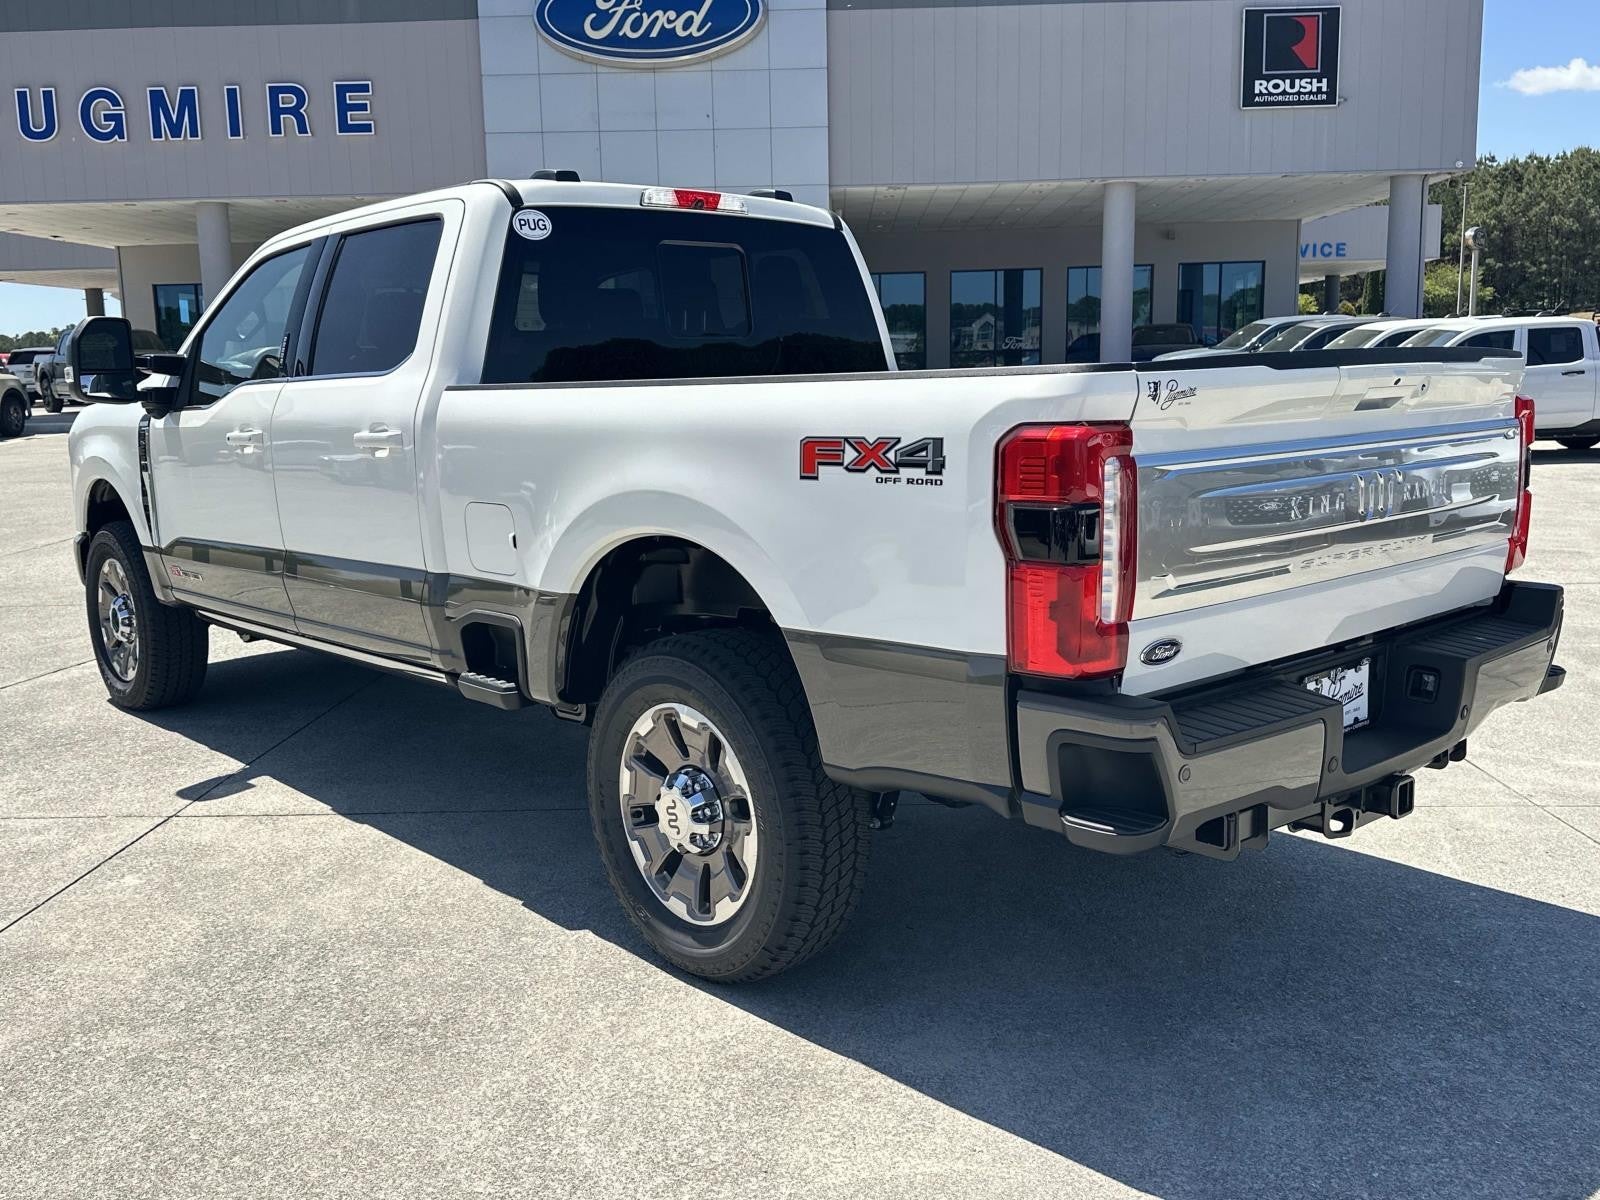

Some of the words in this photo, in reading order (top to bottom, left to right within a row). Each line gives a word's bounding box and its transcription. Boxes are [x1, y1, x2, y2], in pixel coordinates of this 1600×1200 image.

[583, 0, 712, 39] Ford
[1254, 78, 1328, 94] ROUSH
[1254, 94, 1299, 103] AUTHORIZED
[1299, 93, 1327, 101] DEALER
[14, 80, 375, 142] UGMIRE
[517, 218, 548, 231] PUG
[1300, 242, 1347, 258] VICE
[799, 436, 946, 481] FX4
[875, 477, 901, 485] OFF
[906, 478, 943, 486] ROAD
[1290, 492, 1345, 520] KING
[1152, 644, 1176, 660] Ford
